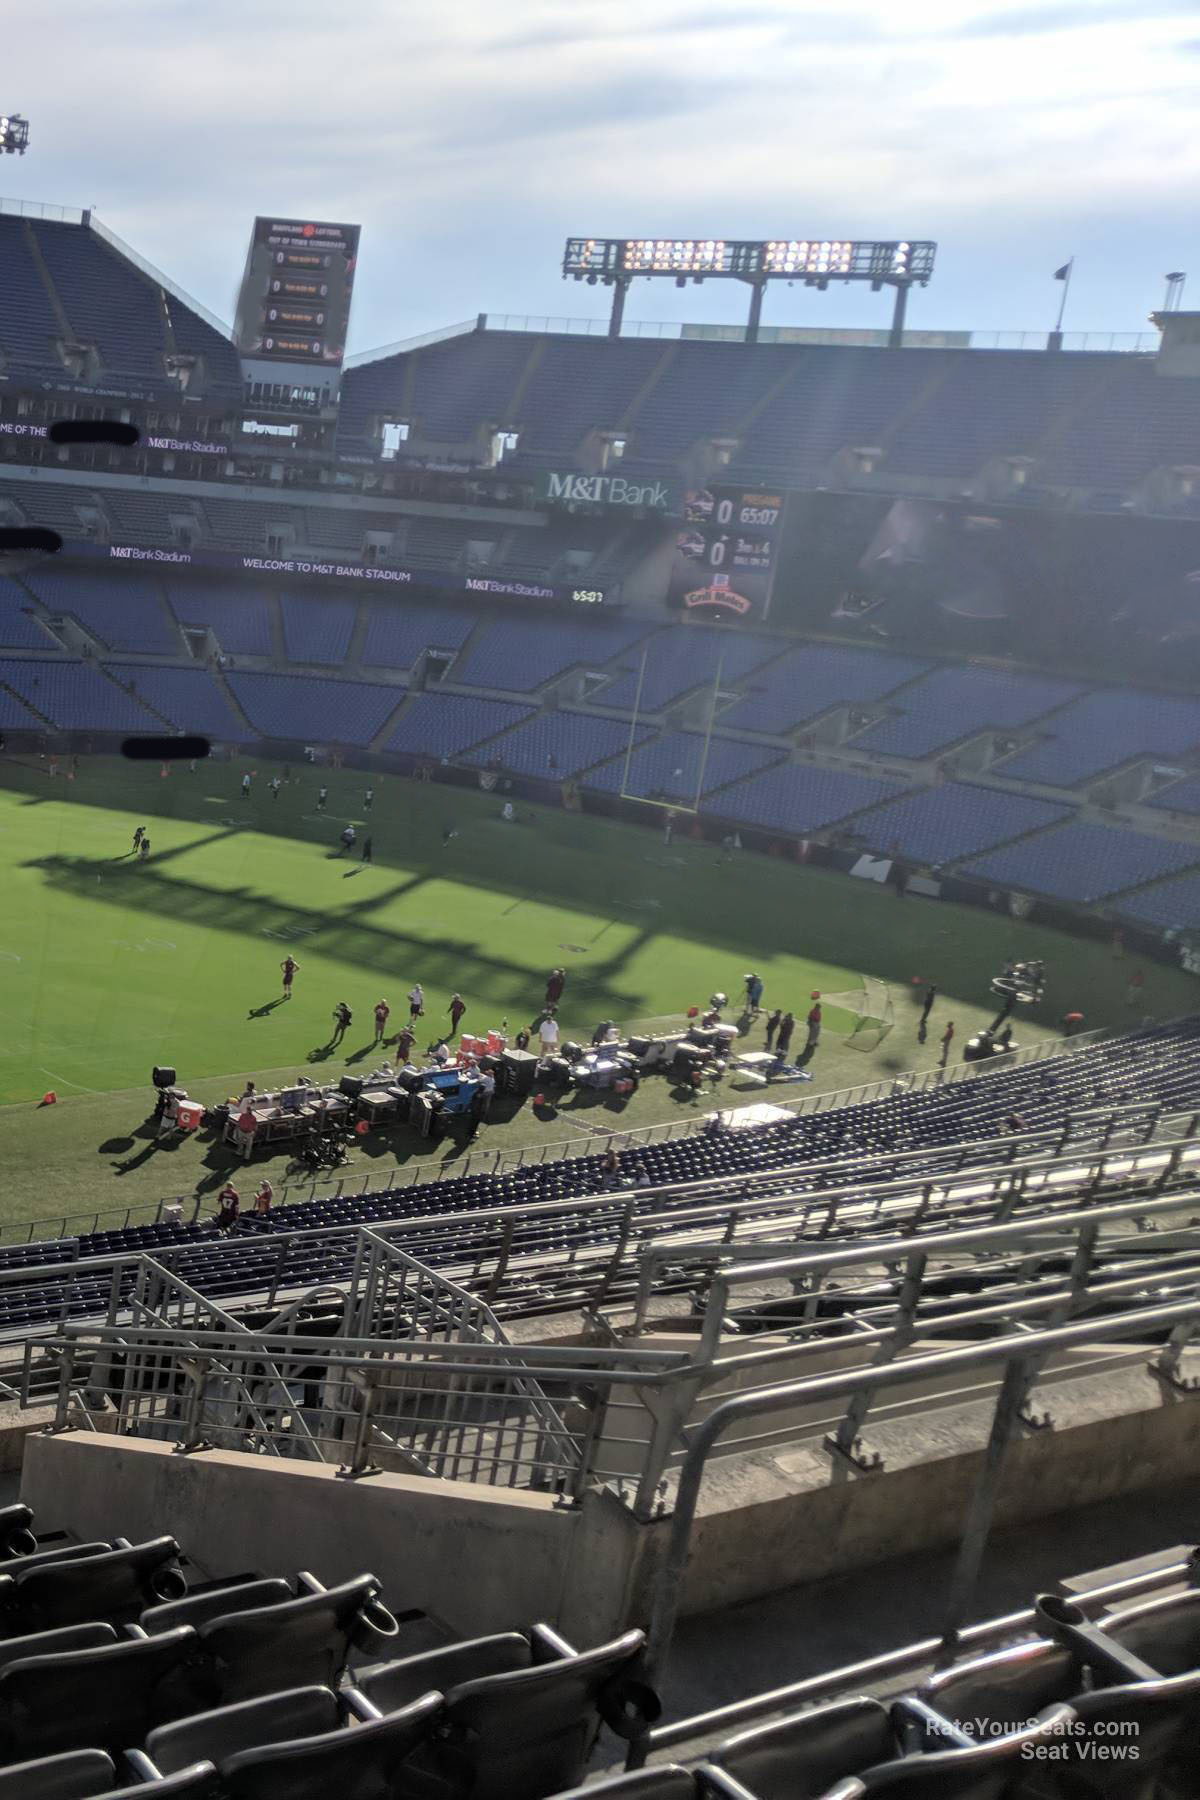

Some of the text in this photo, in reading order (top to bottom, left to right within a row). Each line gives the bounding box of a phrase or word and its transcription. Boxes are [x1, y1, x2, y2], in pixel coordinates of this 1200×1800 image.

[15, 424, 27, 435] OF
[29, 426, 47, 437] THE
[149, 437, 171, 449] M&T
[192, 441, 227, 454] Stadium
[547, 473, 668, 507] M&T Bank
[717, 499, 733, 524] 0
[740, 507, 779, 526] 65:07
[110, 546, 191, 563] M&T Bank Stadium
[711, 542, 725, 566] 0
[243, 557, 411, 582] WELCOME TO M&T BANK STADIUM
[466, 578, 491, 591] M&T
[514, 583, 553, 597] Stadium
